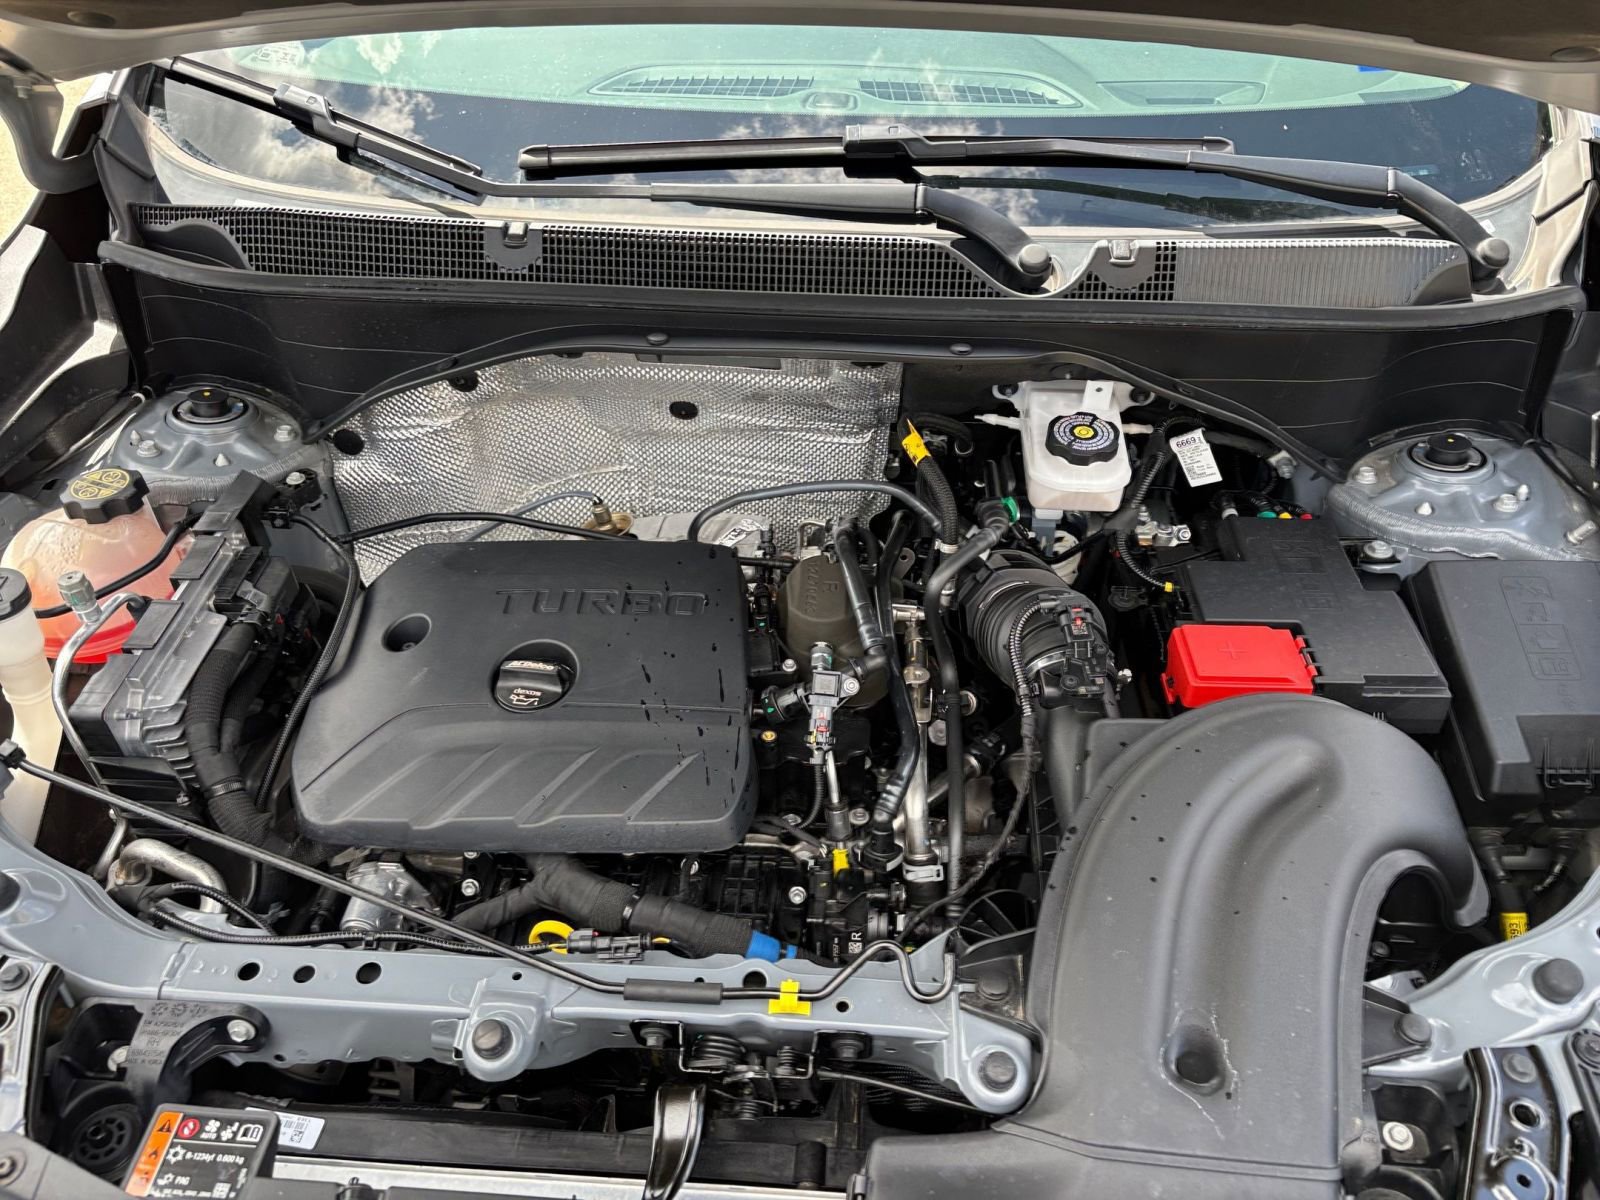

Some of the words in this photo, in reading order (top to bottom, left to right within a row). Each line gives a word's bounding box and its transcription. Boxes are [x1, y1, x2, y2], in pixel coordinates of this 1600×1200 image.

[1176, 437, 1196, 448] 6669
[496, 588, 706, 615] TURBO
[506, 660, 555, 670] ACDelco
[513, 687, 542, 696] dexos
[851, 932, 862, 941] R
[185, 1151, 215, 1163] R-1234yf
[235, 1156, 245, 1165] kg
[174, 1176, 191, 1186] PAG
